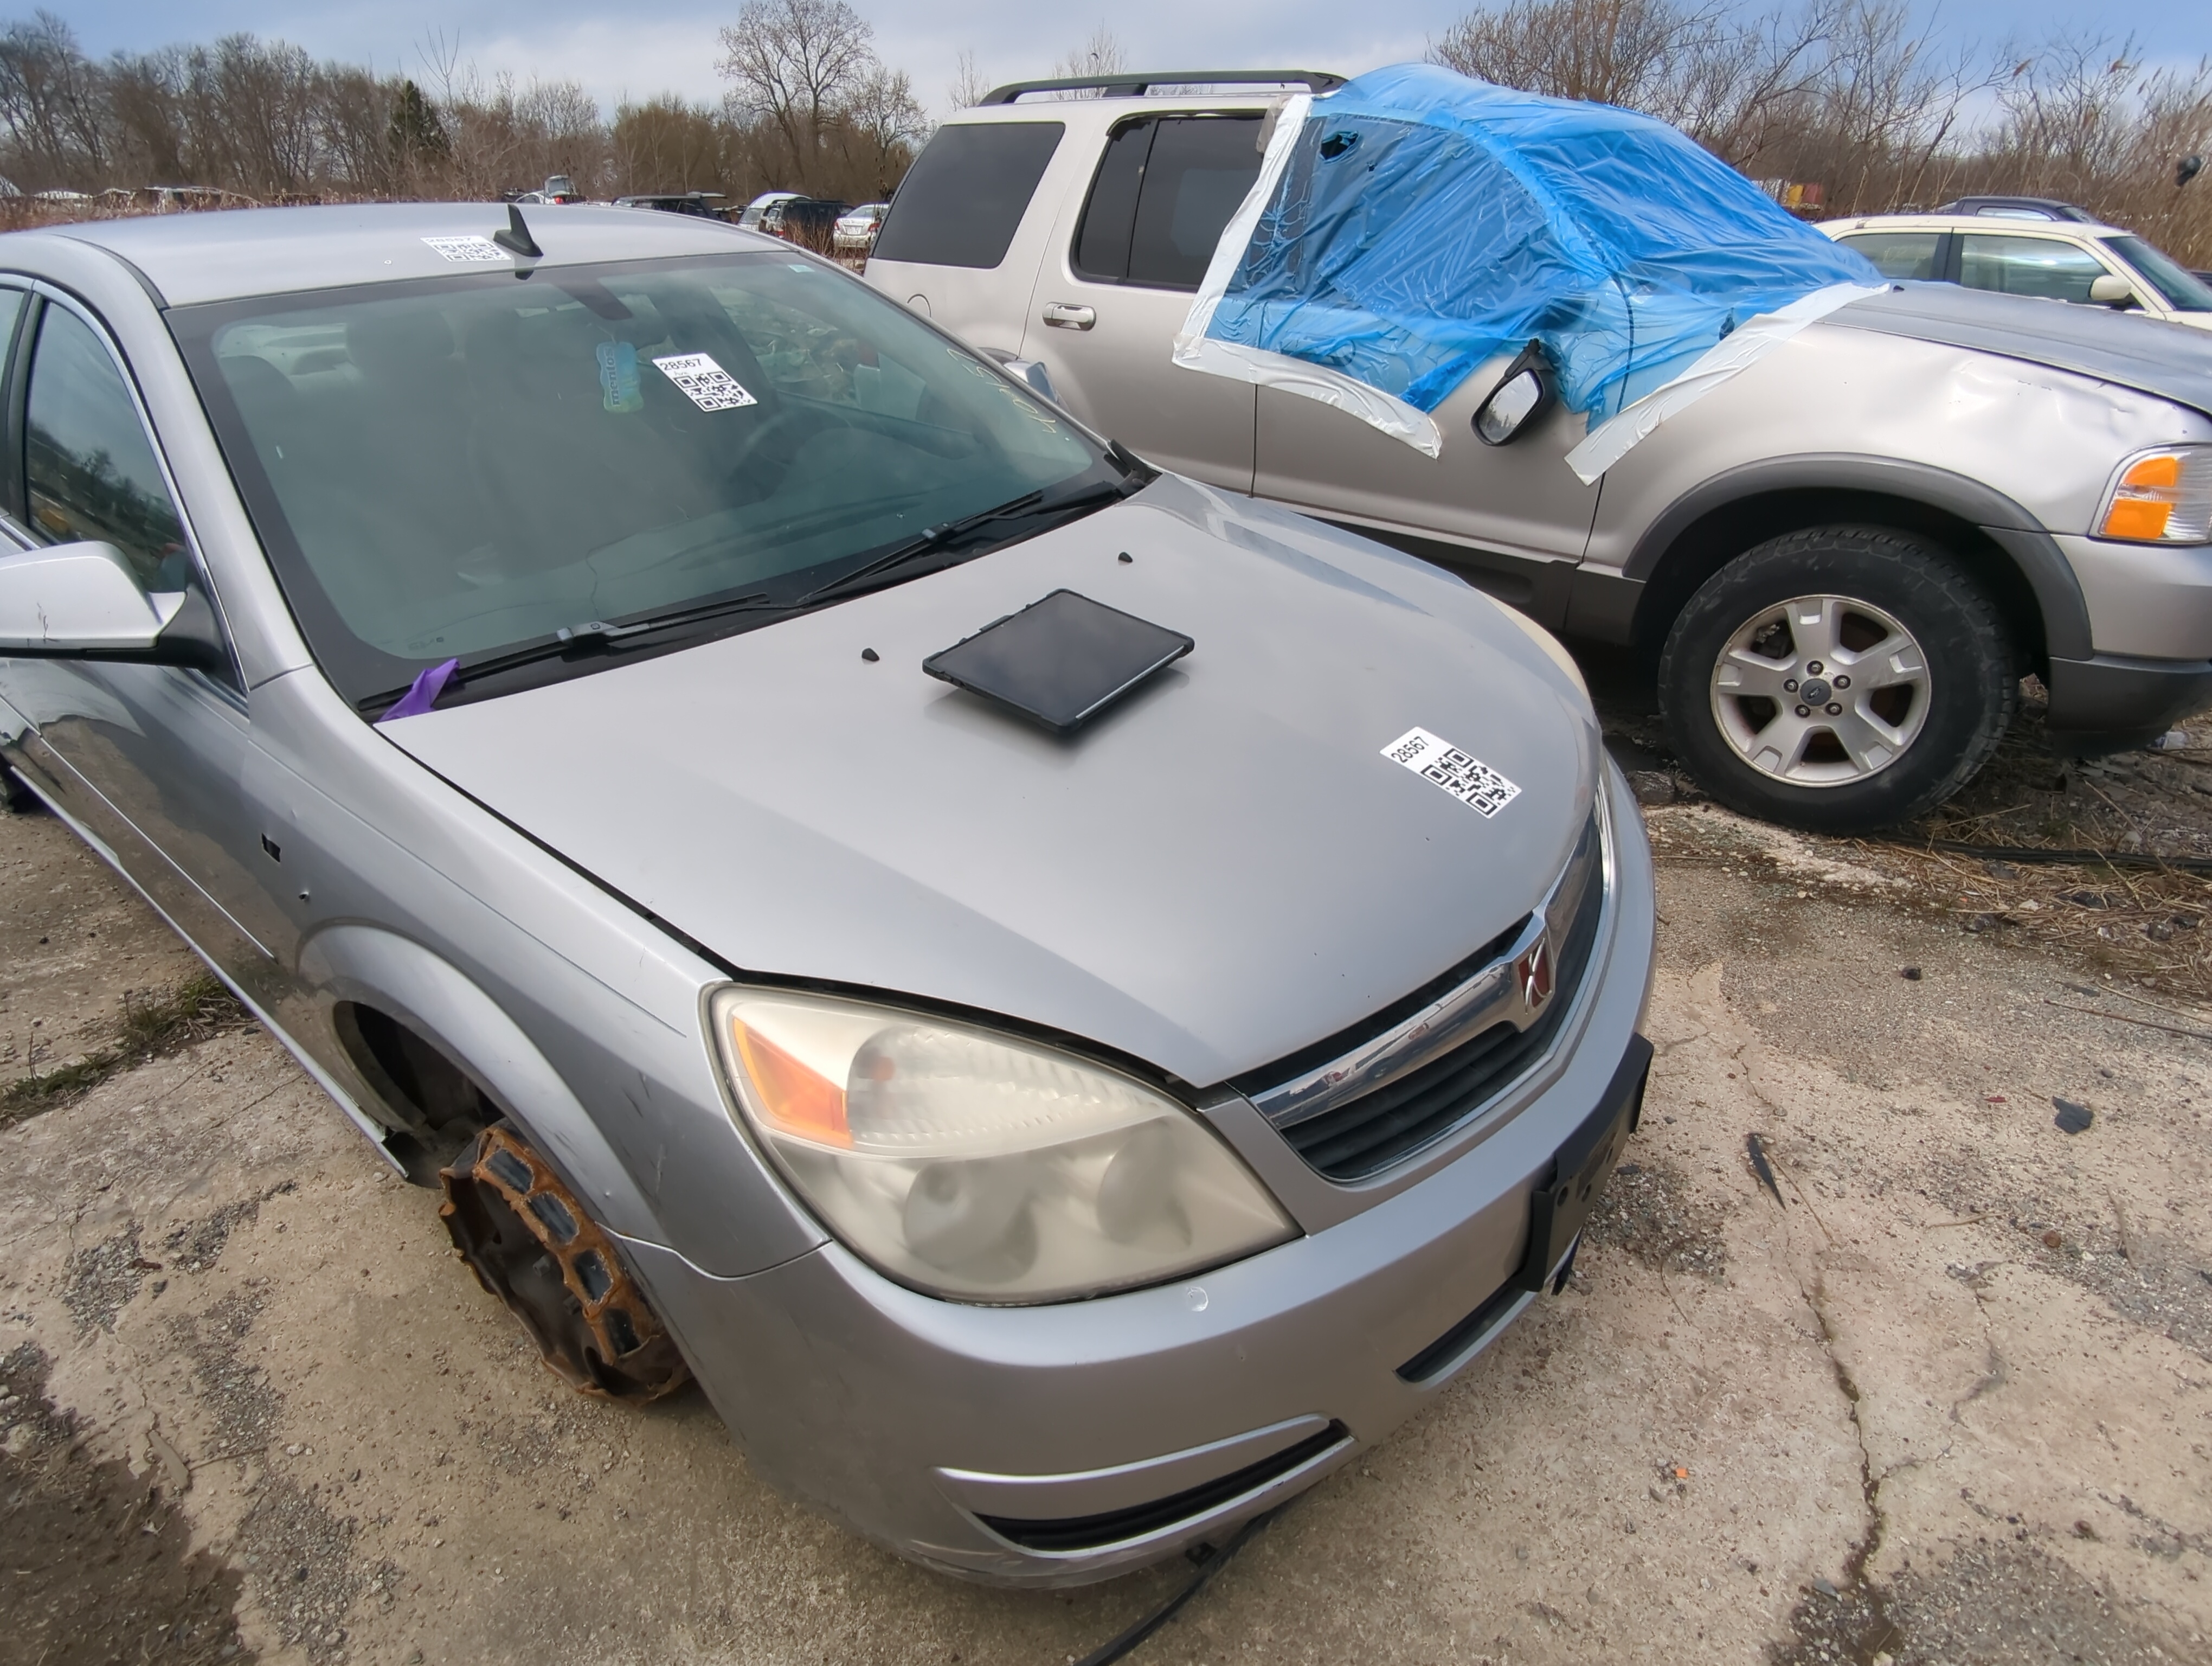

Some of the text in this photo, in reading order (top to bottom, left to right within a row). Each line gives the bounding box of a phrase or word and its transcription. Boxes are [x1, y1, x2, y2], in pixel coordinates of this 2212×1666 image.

[605, 347, 620, 406] mentos
[660, 358, 701, 370] 28567
[1391, 736, 1429, 763] 28567
